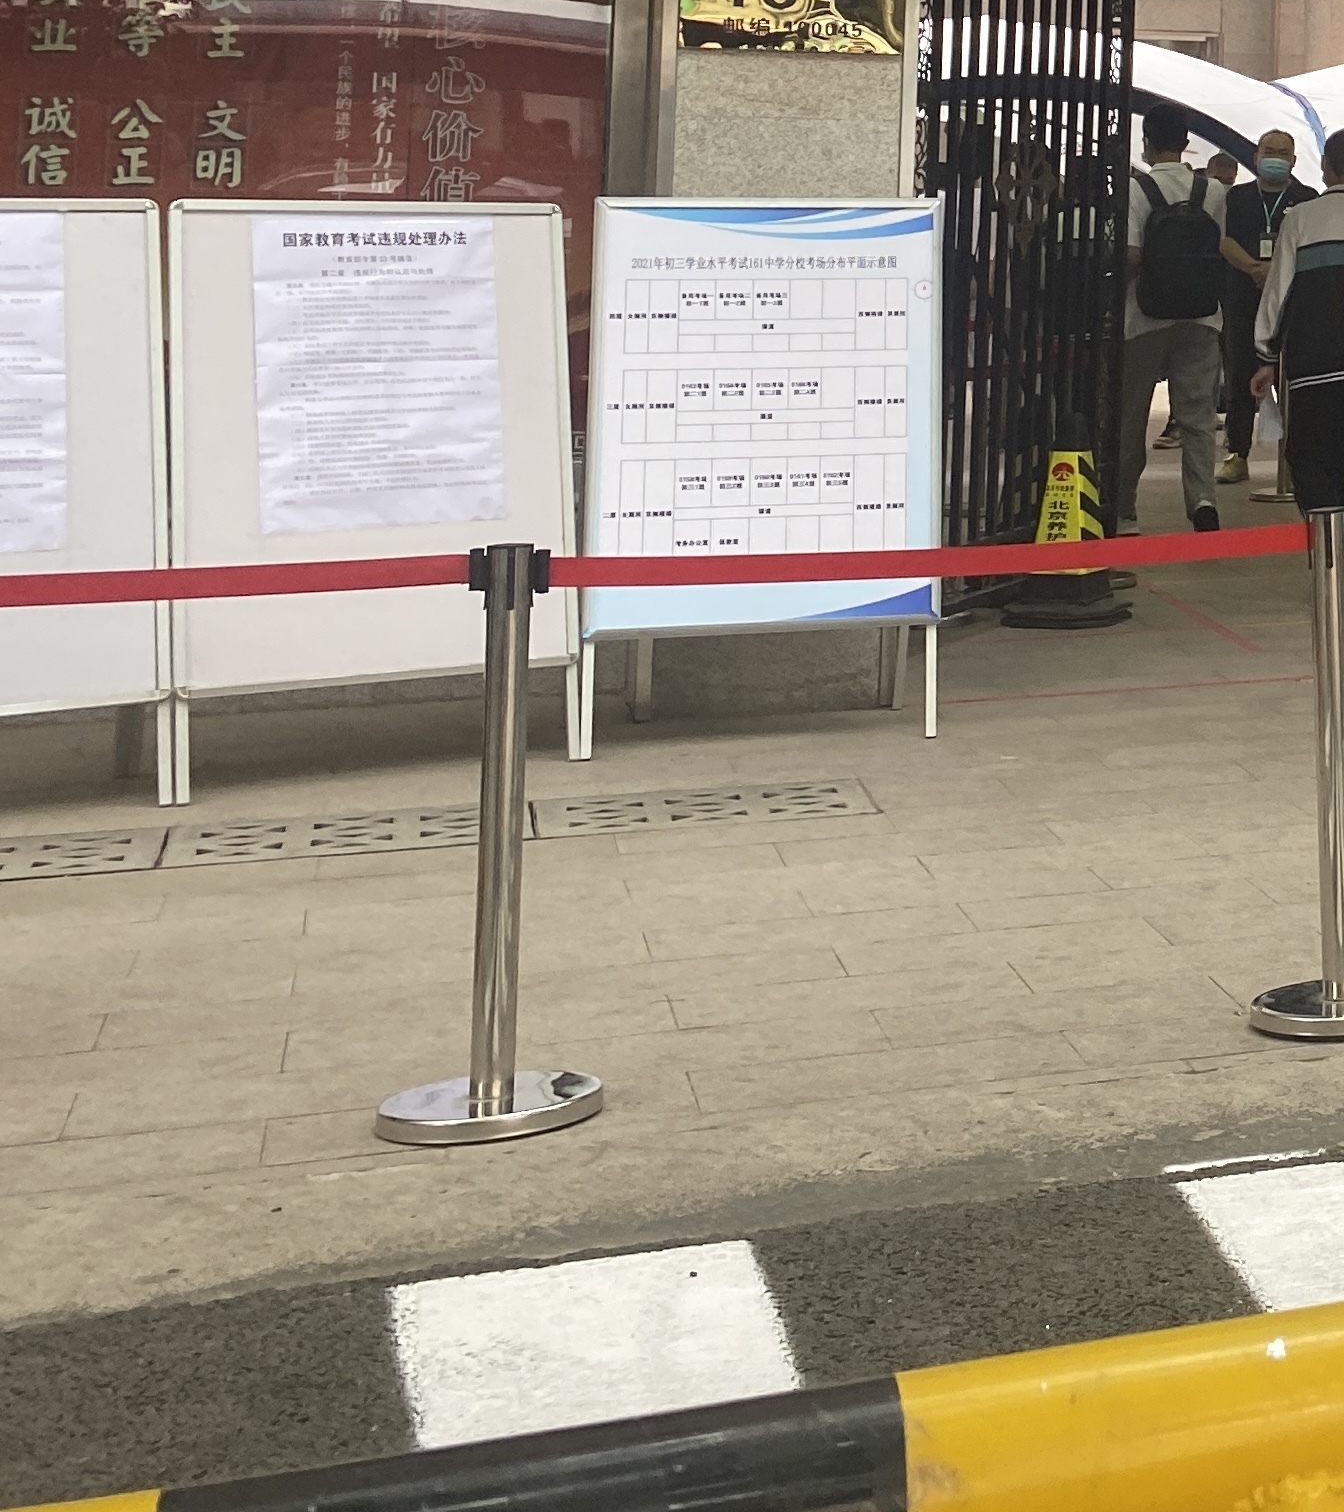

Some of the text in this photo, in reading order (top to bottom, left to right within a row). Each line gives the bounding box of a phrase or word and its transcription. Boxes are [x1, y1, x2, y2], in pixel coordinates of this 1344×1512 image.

[20, 96, 77, 186] 诚信
[110, 98, 164, 186] 公正
[195, 99, 248, 189] 文明
[283, 231, 467, 248] 国家教育考试违规处理办法
